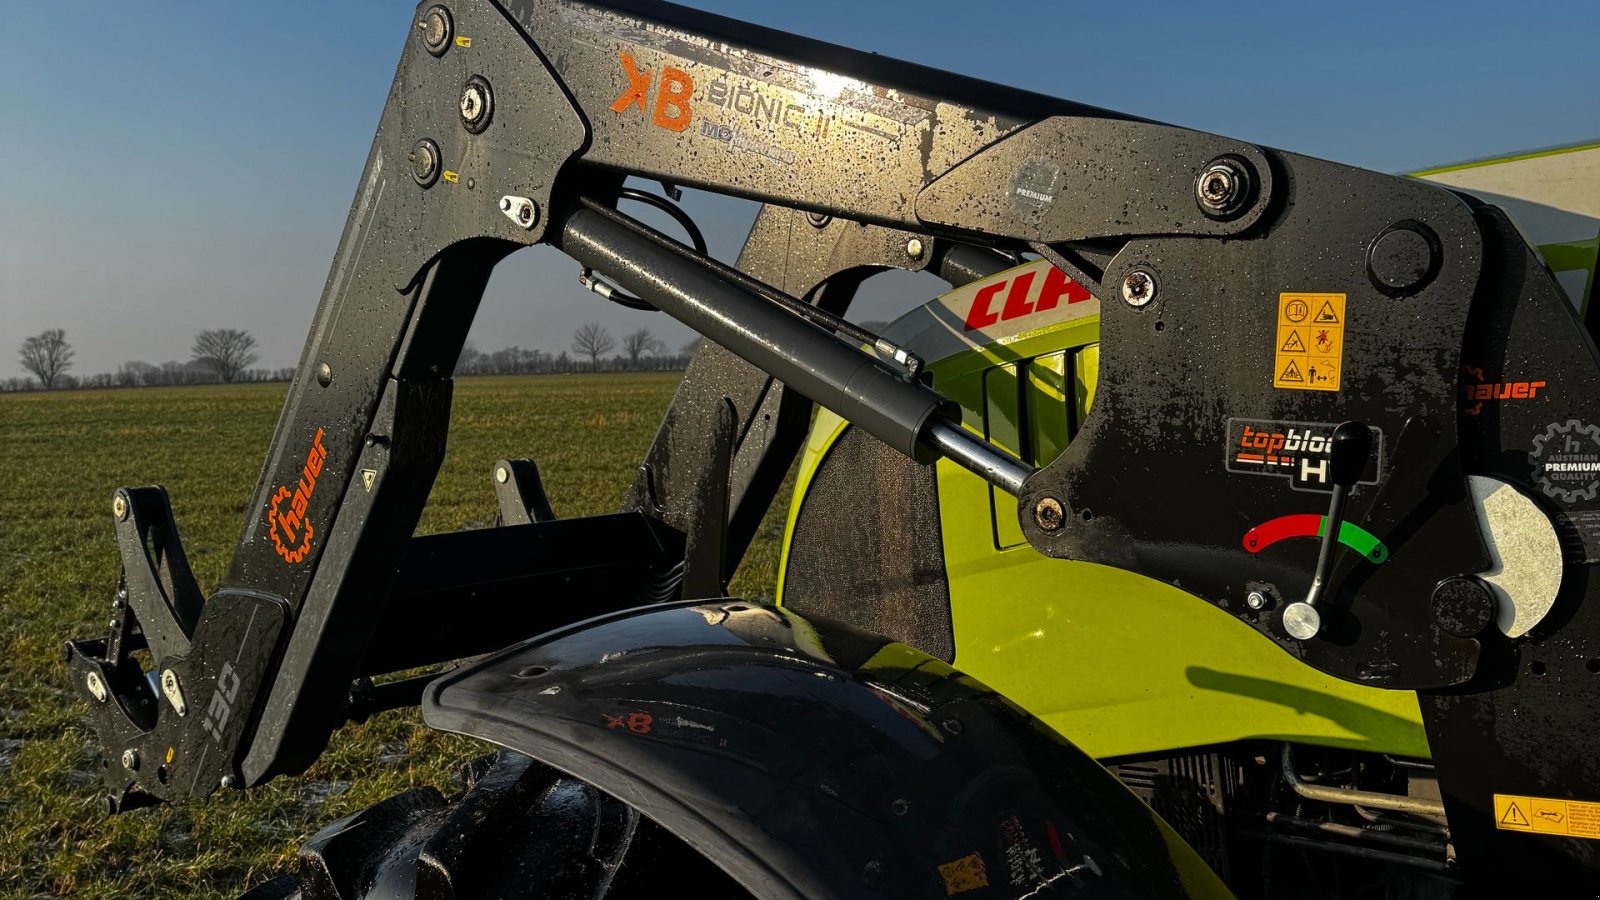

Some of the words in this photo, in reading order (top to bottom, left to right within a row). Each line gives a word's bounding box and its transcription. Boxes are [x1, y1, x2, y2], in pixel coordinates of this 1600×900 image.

[706, 77, 806, 130] BIONIC
[1016, 187, 1053, 203] PREMIUM
[963, 266, 1091, 332] CLA
[1548, 454, 1598, 463] AUSTRIAN
[1545, 462, 1600, 472] PREMIUM
[1550, 472, 1597, 481] QUALITY
[278, 427, 327, 544] hauer
